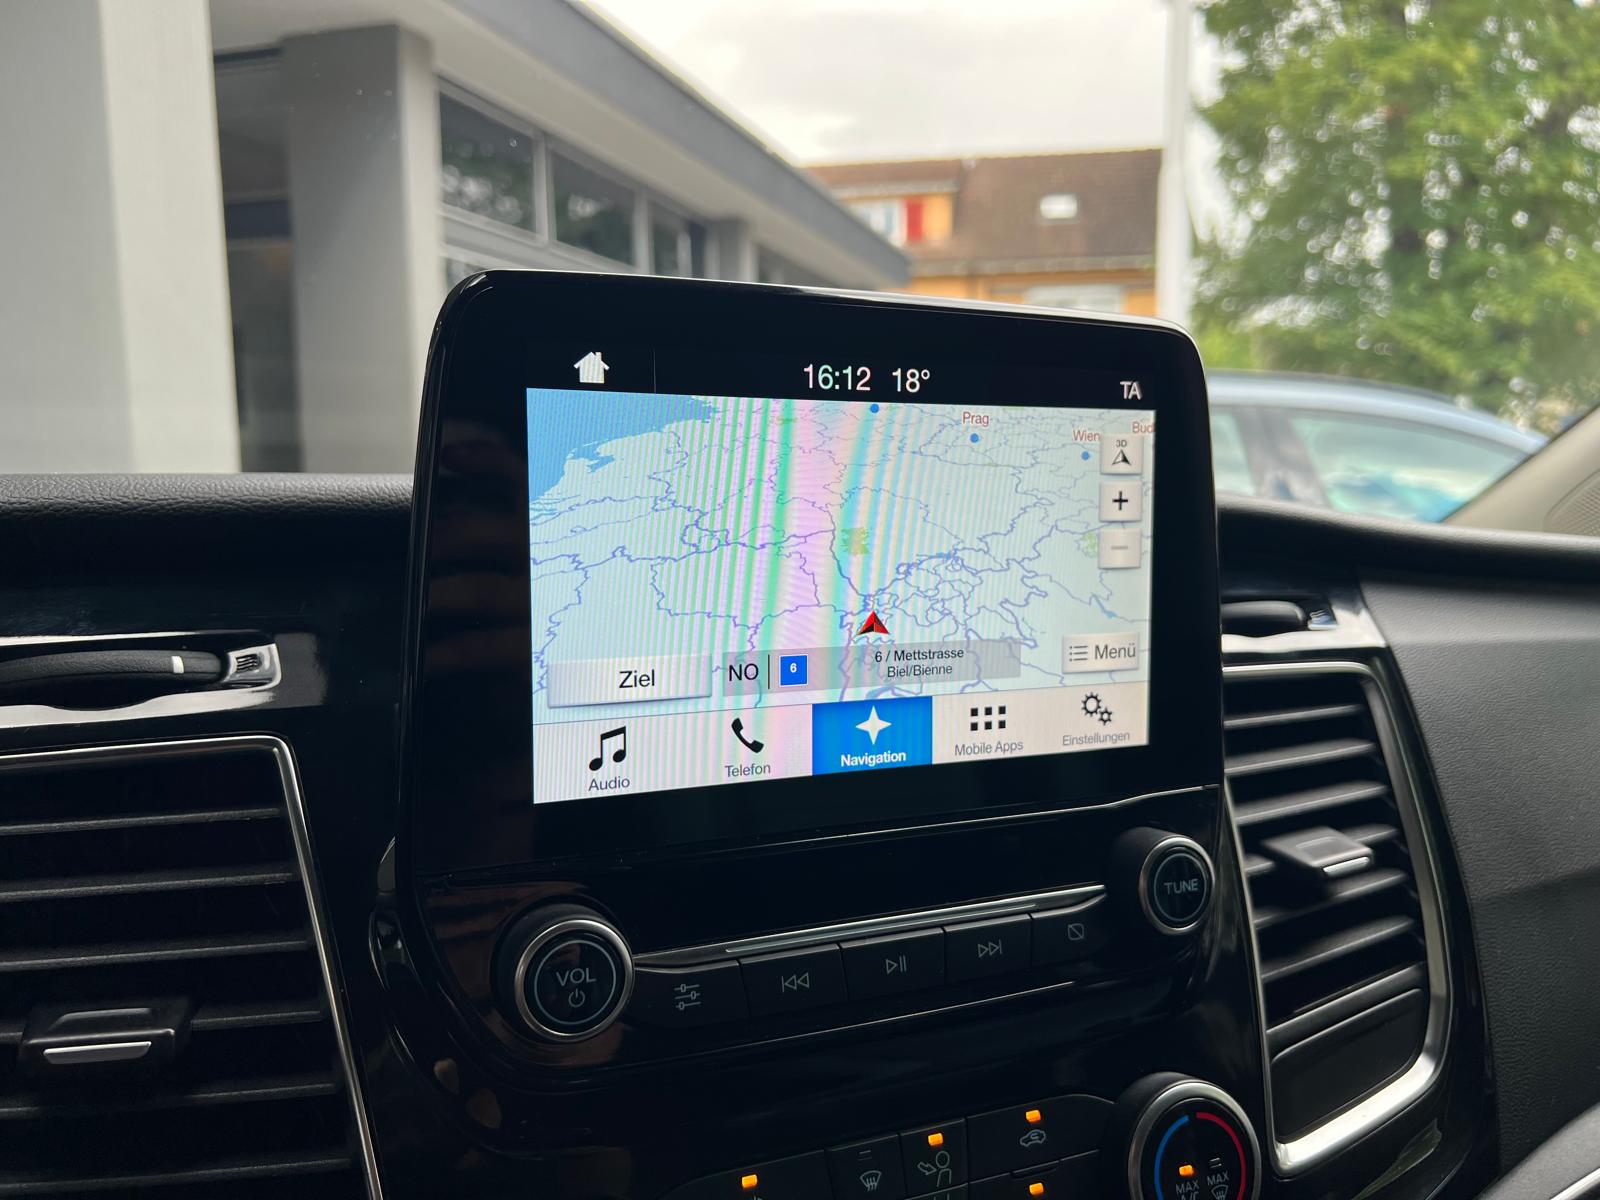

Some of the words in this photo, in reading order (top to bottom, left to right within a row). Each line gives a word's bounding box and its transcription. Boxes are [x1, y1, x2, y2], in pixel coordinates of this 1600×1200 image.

[803, 363, 872, 391] 16:12
[892, 367, 931, 393] 18°
[1119, 380, 1143, 400] TA
[962, 411, 989, 427] Prag
[1073, 429, 1100, 442] Wien
[1115, 439, 1128, 448] 3D
[874, 650, 883, 663] 6
[894, 646, 964, 661] Mettstrasse
[1094, 642, 1136, 660] Menü
[728, 663, 759, 682] NO
[789, 662, 798, 673] 6
[886, 663, 953, 678] Biel/Bienne
[618, 669, 656, 688] Ziel
[1062, 730, 1130, 746] Einstellungen
[954, 742, 993, 757] Mobile
[995, 739, 1024, 755] Apps
[840, 750, 907, 768] Navigation
[724, 762, 771, 778] Telefon
[588, 776, 630, 792] Audio
[1164, 878, 1199, 895] TUNE
[556, 967, 597, 987] VOL
[1206, 1171, 1230, 1186] MAX
[1175, 1180, 1200, 1195] MAX
